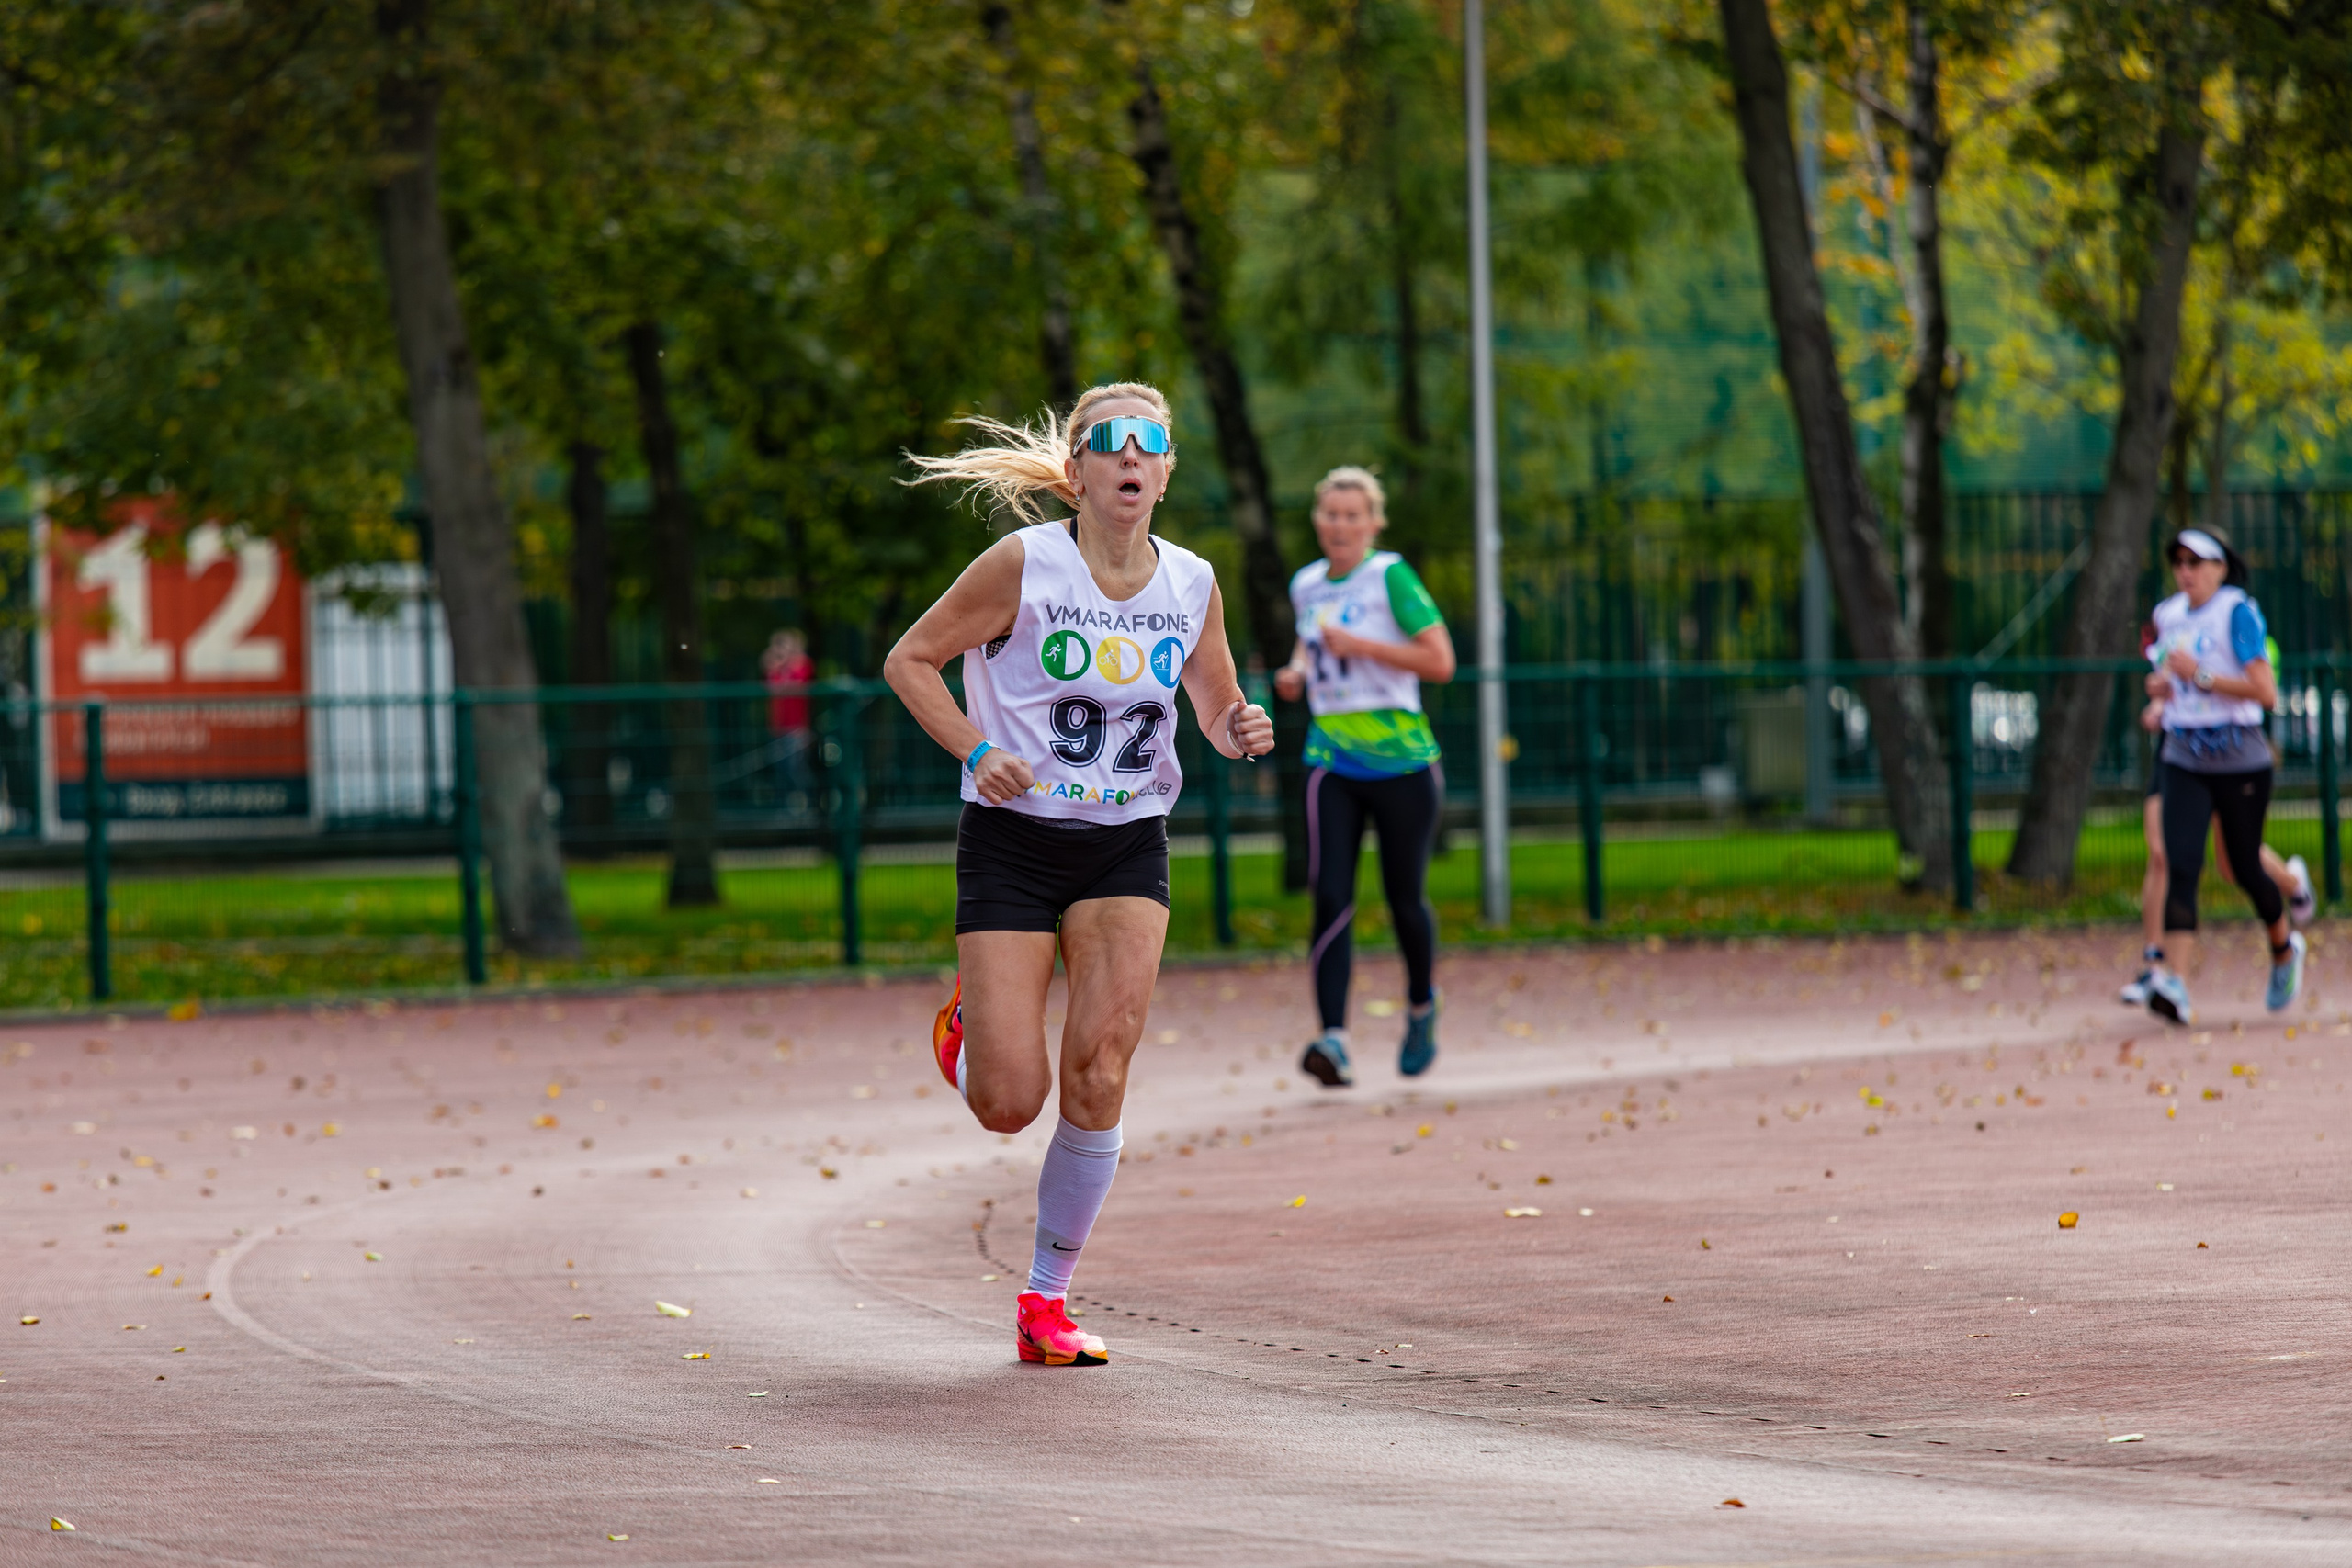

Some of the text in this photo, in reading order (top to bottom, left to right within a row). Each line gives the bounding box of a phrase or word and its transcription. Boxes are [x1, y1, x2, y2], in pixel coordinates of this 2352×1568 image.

[77, 522, 284, 682] 12
[1046, 604, 1189, 634] VMARAFONE
[1049, 695, 1168, 773] 92
